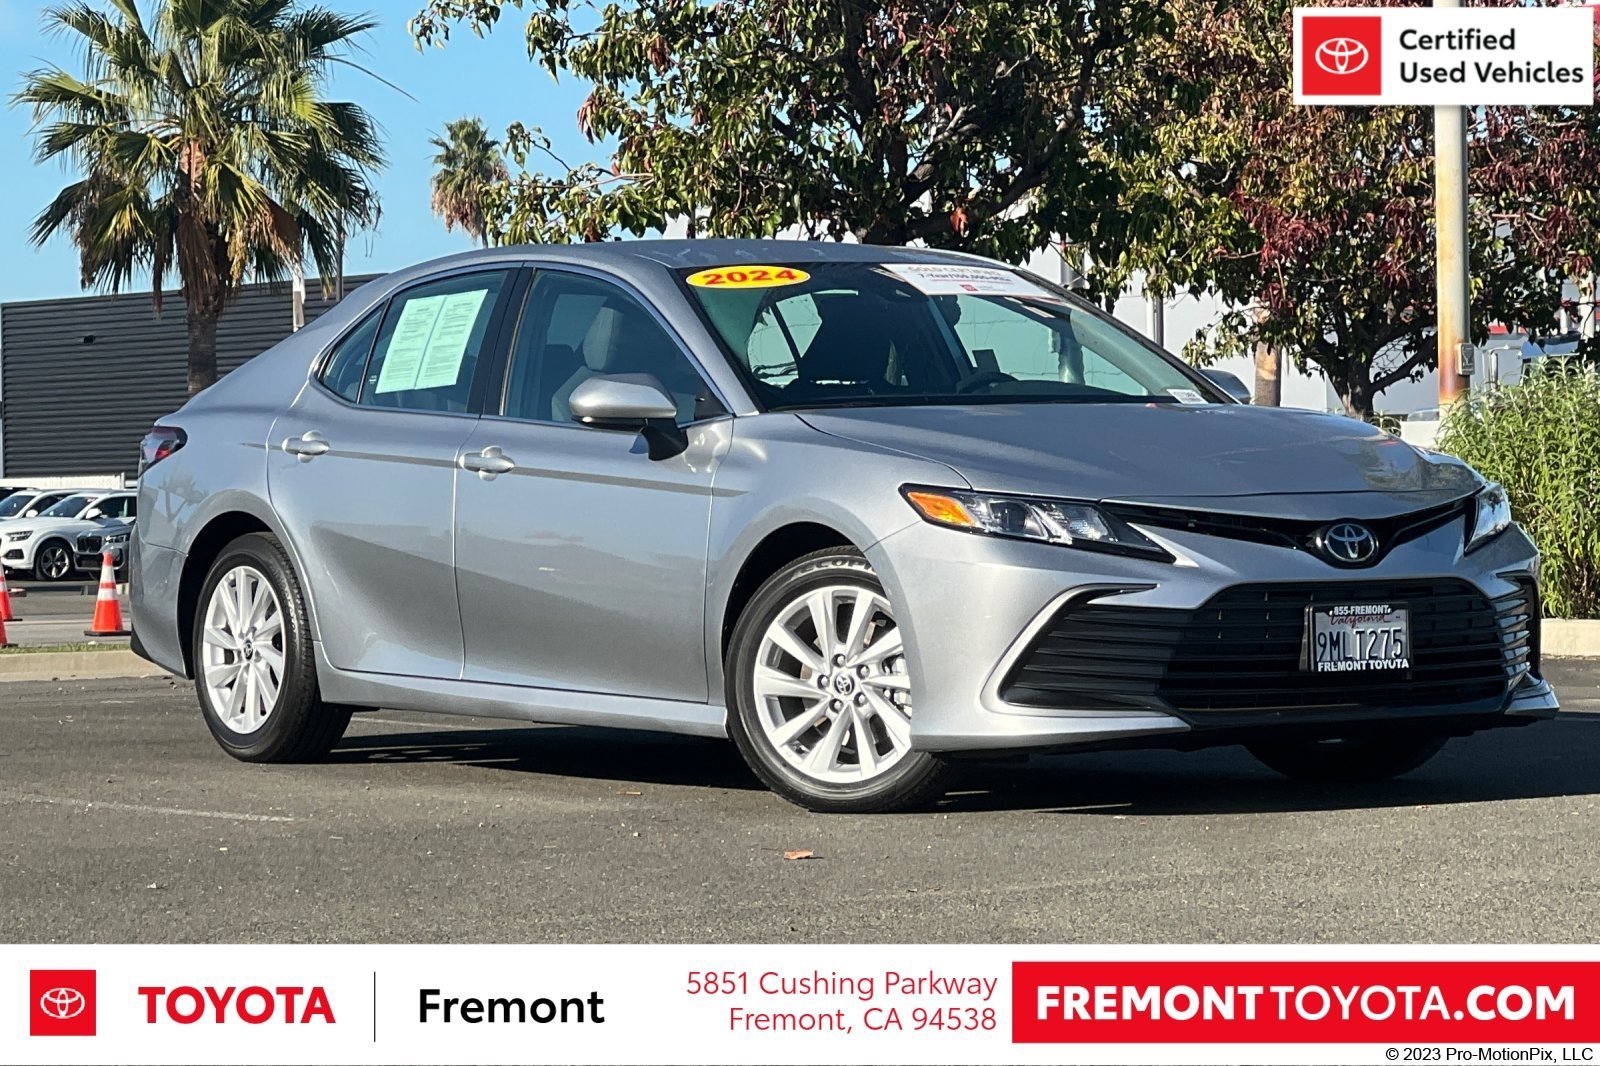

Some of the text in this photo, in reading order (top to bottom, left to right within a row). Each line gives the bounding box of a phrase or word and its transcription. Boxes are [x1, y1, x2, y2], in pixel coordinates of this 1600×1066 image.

[703, 270, 796, 285] 2024
[1333, 605, 1389, 616] 855-FREMONT
[1317, 627, 1403, 662] 9MLT275
[1317, 658, 1409, 672] FREMONT TOYOTA
